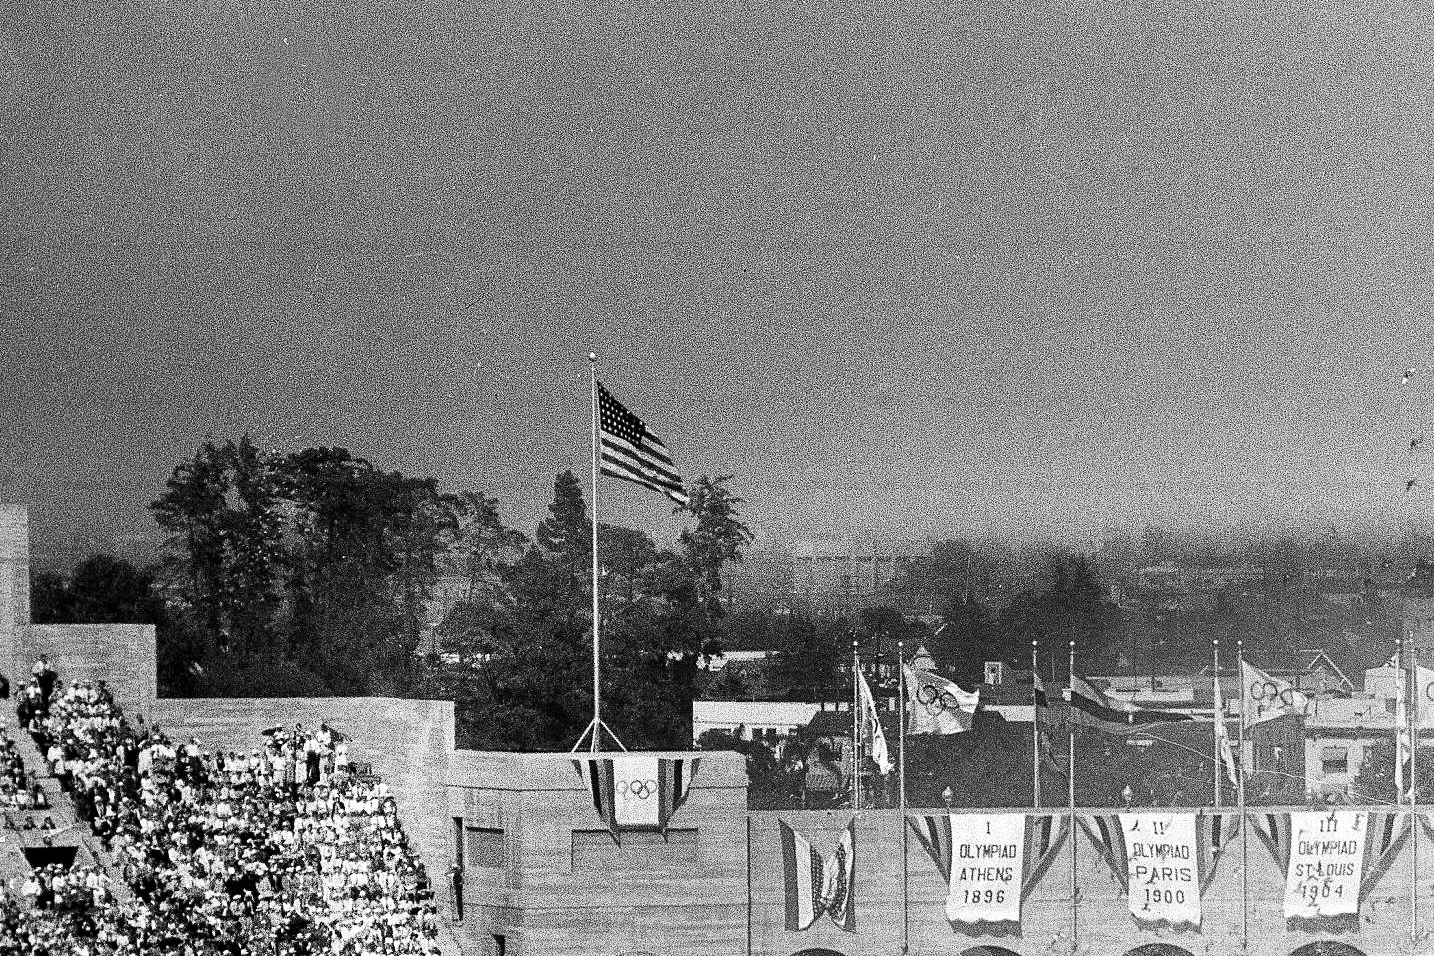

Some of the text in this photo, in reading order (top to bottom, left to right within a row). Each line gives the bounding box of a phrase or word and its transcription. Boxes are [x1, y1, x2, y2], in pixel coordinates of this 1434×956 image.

[986, 821, 991, 835] I
[1320, 819, 1338, 832] III
[959, 844, 1017, 858] OLYMPIAD
[1133, 842, 1190, 859] OLYMPIAD
[1299, 840, 1357, 855] OLYMPIAD
[960, 867, 1013, 881] ATHENS
[1136, 865, 1192, 881] PARIS
[1318, 862, 1354, 877] LOUIS
[964, 889, 1005, 903] 1896
[1145, 888, 1185, 903] 1900
[1302, 884, 1343, 901] 1904
